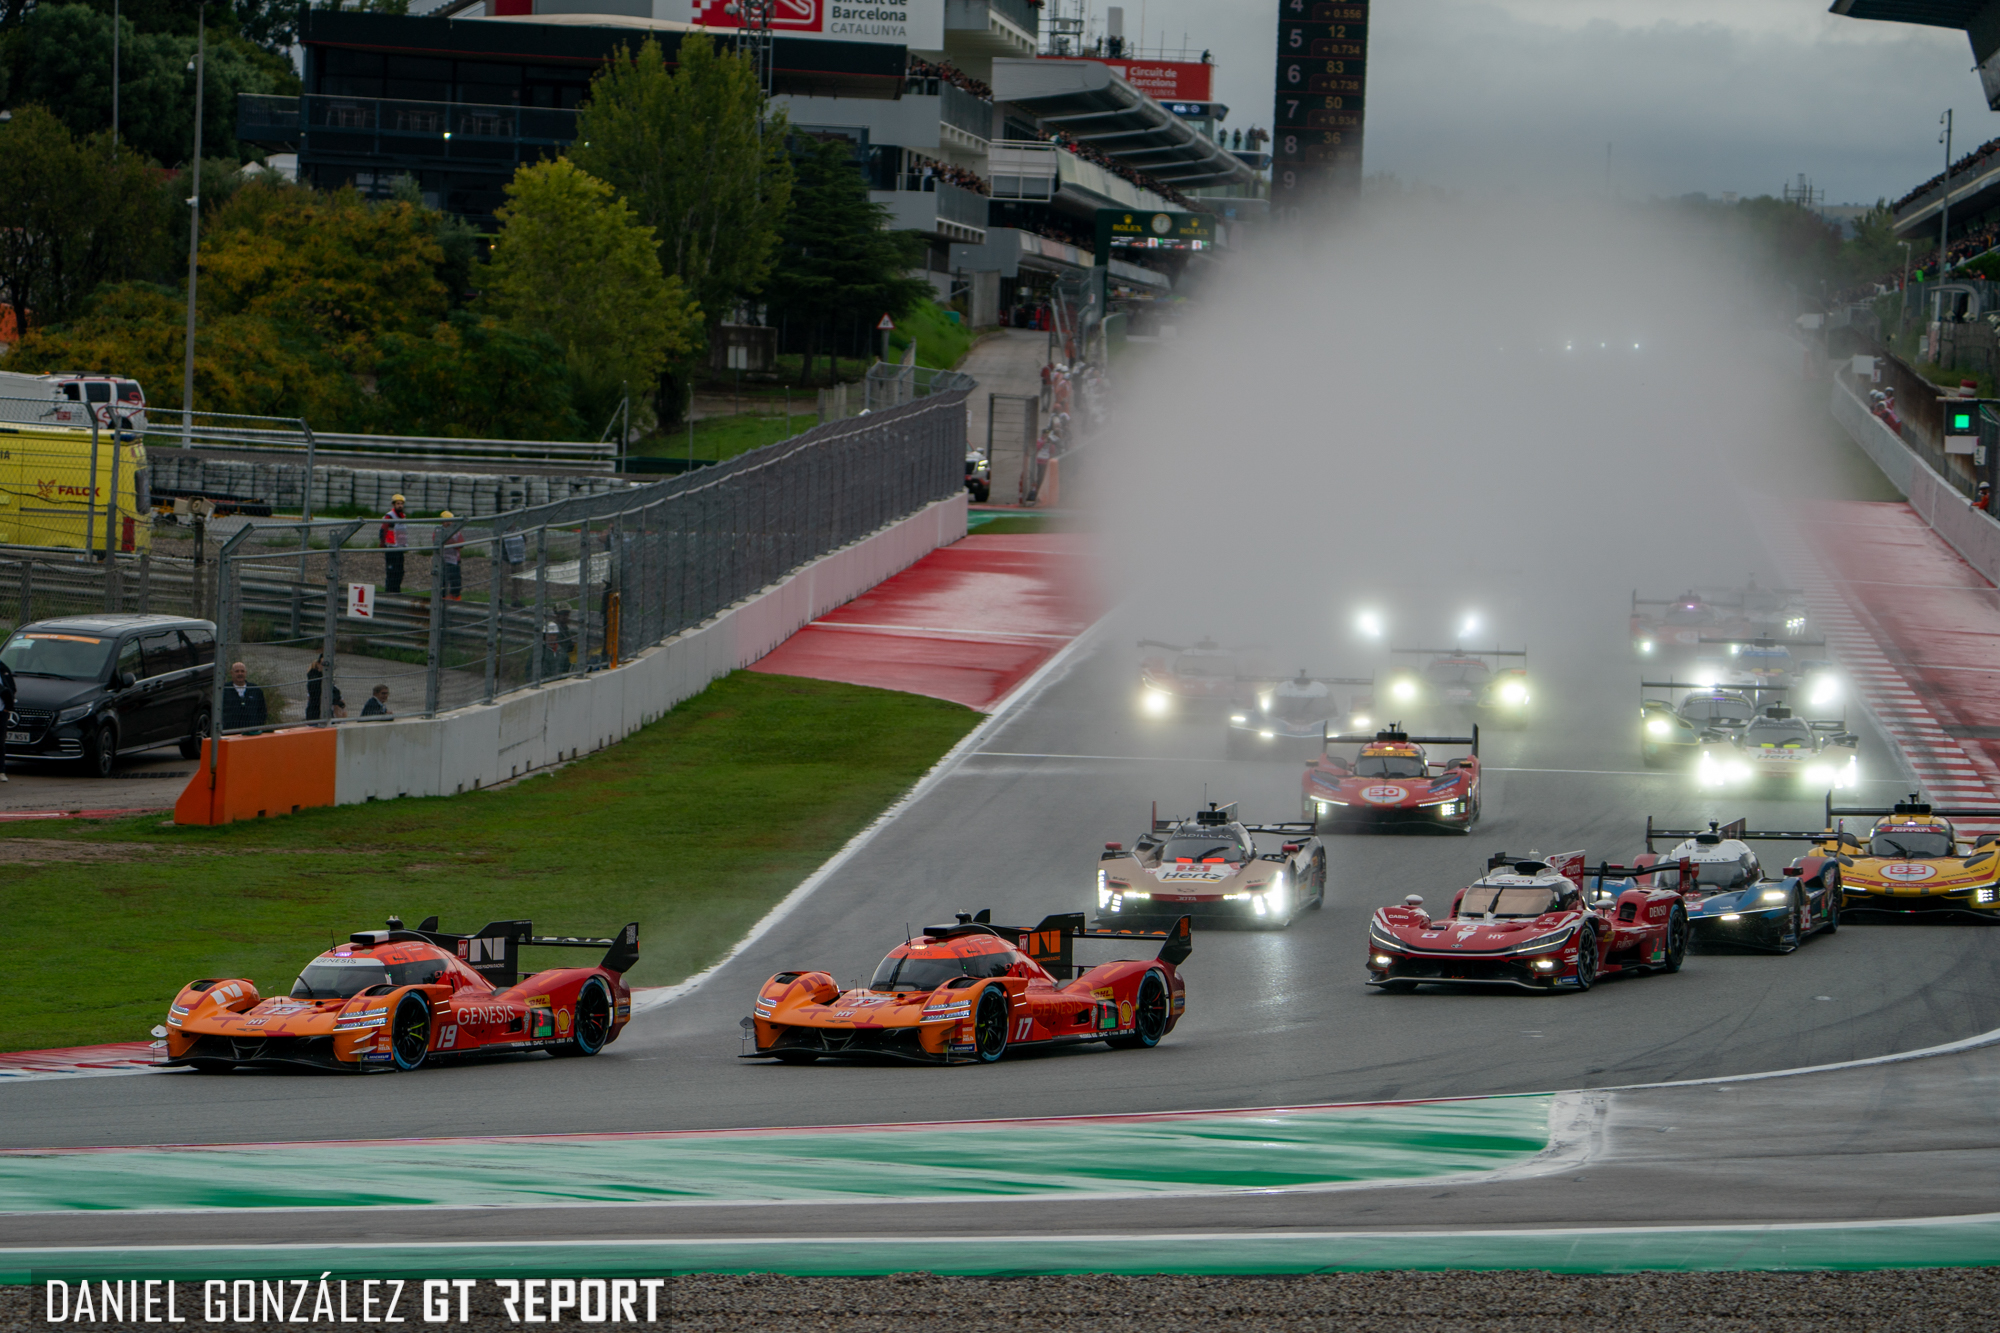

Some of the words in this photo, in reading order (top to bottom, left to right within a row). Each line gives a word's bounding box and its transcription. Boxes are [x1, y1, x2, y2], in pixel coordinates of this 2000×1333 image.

[832, 5, 907, 21] Barcelona
[1333, 9, 1361, 19] 0.556
[830, 22, 906, 37] CATALUNYA
[1328, 25, 1345, 38] 12
[1289, 28, 1302, 48] 5
[1331, 44, 1360, 54] 0.734
[1130, 66, 1164, 78] Circuit
[1164, 68, 1177, 79] de
[1326, 60, 1344, 73] 83
[1287, 64, 1301, 83] 6
[1130, 77, 1177, 88] Barcelona
[1329, 80, 1359, 90] 0.738
[1286, 99, 1299, 118] 7
[1325, 96, 1343, 109] 50
[1328, 116, 1357, 125] 0.934
[1323, 131, 1341, 144] 36
[1284, 135, 1297, 154] 8
[1283, 170, 1296, 189] 9
[1112, 224, 1142, 232] ROLEX
[1179, 227, 1208, 235] ROLEX
[1373, 749, 1407, 757] Ferrari
[1369, 786, 1398, 797] 50
[1891, 825, 1931, 833] Ferrari
[1161, 871, 1224, 880] Hertz
[1891, 866, 1925, 875] 83
[1649, 905, 1667, 918] DENSO
[458, 943, 467, 956] HY
[1020, 937, 1028, 950] HY
[315, 957, 357, 965] GENESIS
[1093, 989, 1111, 999] DHL
[529, 998, 547, 1007] DHL
[1031, 999, 1083, 1017] GENESIS
[457, 1005, 516, 1026] GENESIS
[1015, 1017, 1033, 1040] 17
[437, 1025, 458, 1049] 19
